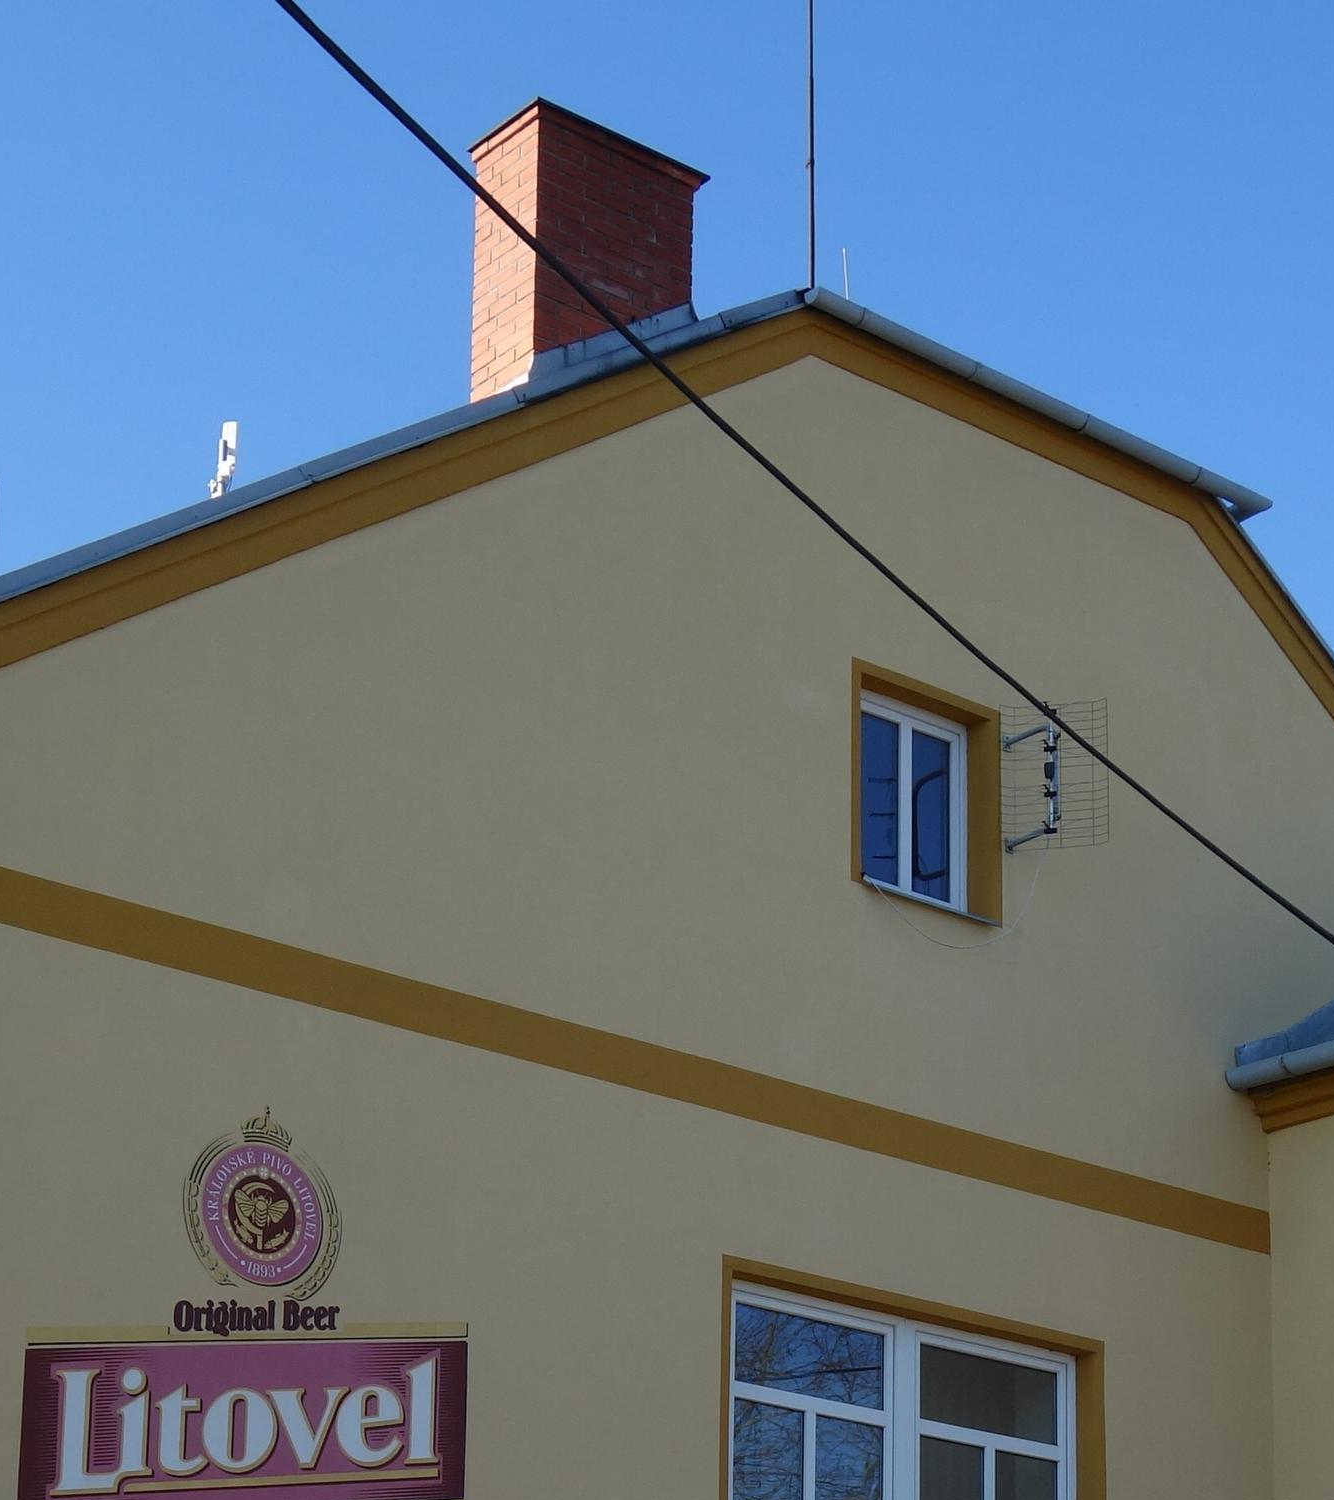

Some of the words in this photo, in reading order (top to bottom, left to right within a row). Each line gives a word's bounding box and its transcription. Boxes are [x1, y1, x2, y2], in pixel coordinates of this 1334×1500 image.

[207, 1147, 256, 1222] KRÁLOVSKÉ
[262, 1151, 292, 1176] PIVO
[293, 1176, 317, 1240] LITOVEL
[246, 1260, 276, 1278] 1893
[173, 1300, 275, 1336] Original
[283, 1300, 340, 1331] Beer
[51, 1349, 440, 1497] Litovel
